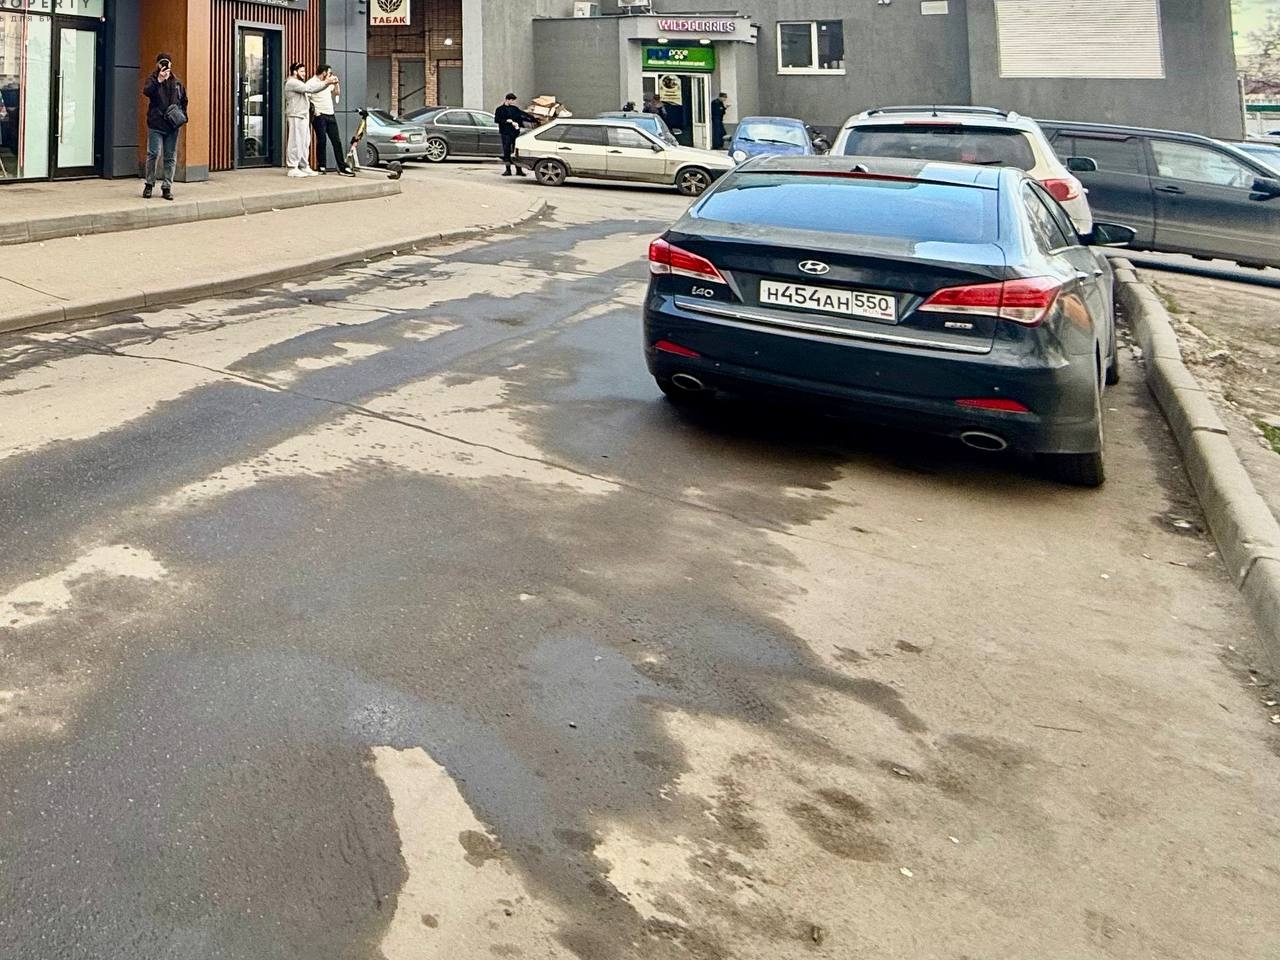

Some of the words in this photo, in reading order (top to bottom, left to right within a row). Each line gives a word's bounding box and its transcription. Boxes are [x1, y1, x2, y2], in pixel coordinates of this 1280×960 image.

[373, 16, 407, 24] ТАБАК
[767, 285, 850, 311] Н454АН
[854, 294, 889, 312] 550
